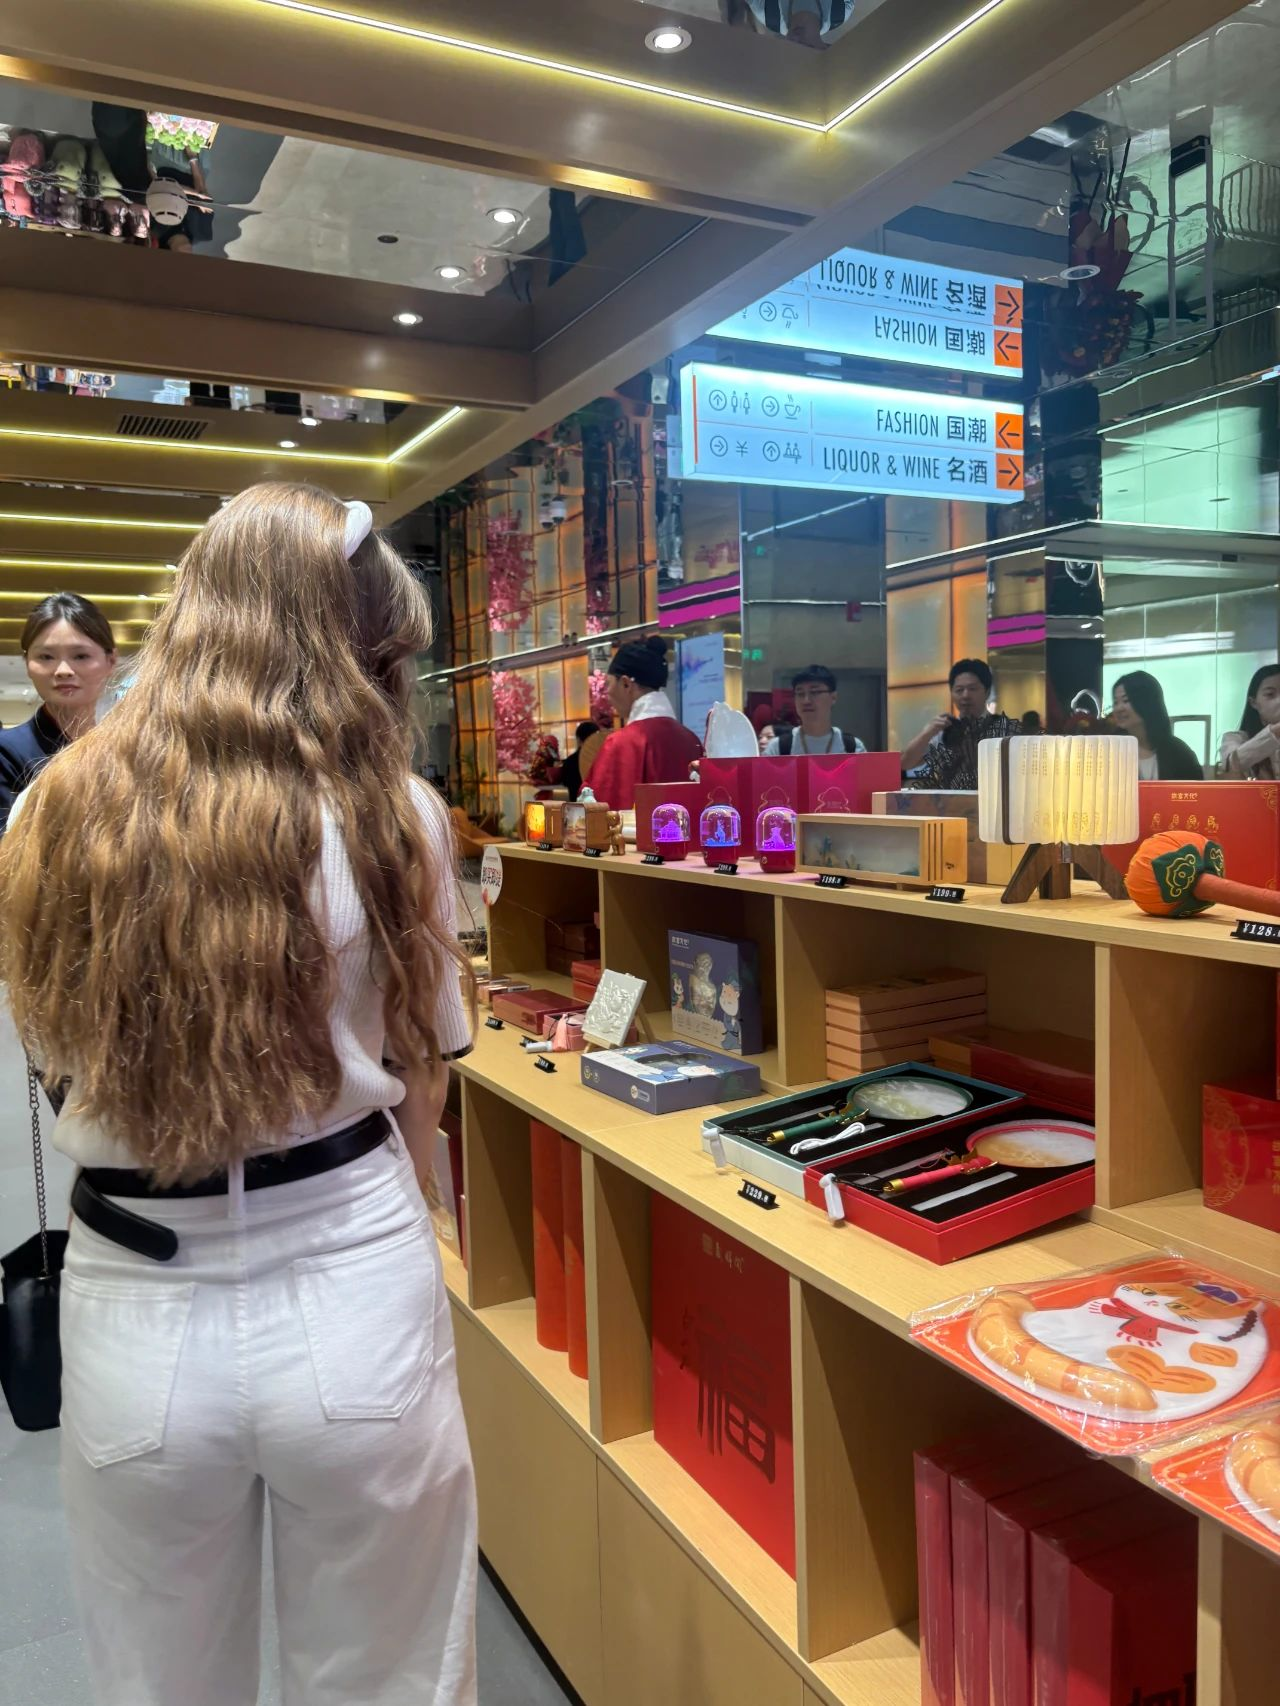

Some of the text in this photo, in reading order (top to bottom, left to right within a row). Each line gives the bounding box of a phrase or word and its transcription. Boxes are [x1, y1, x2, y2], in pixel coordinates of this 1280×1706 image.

[877, 409, 987, 443] FASHION 国潮
[824, 447, 988, 485] LIQUOR & WINE 名酒
